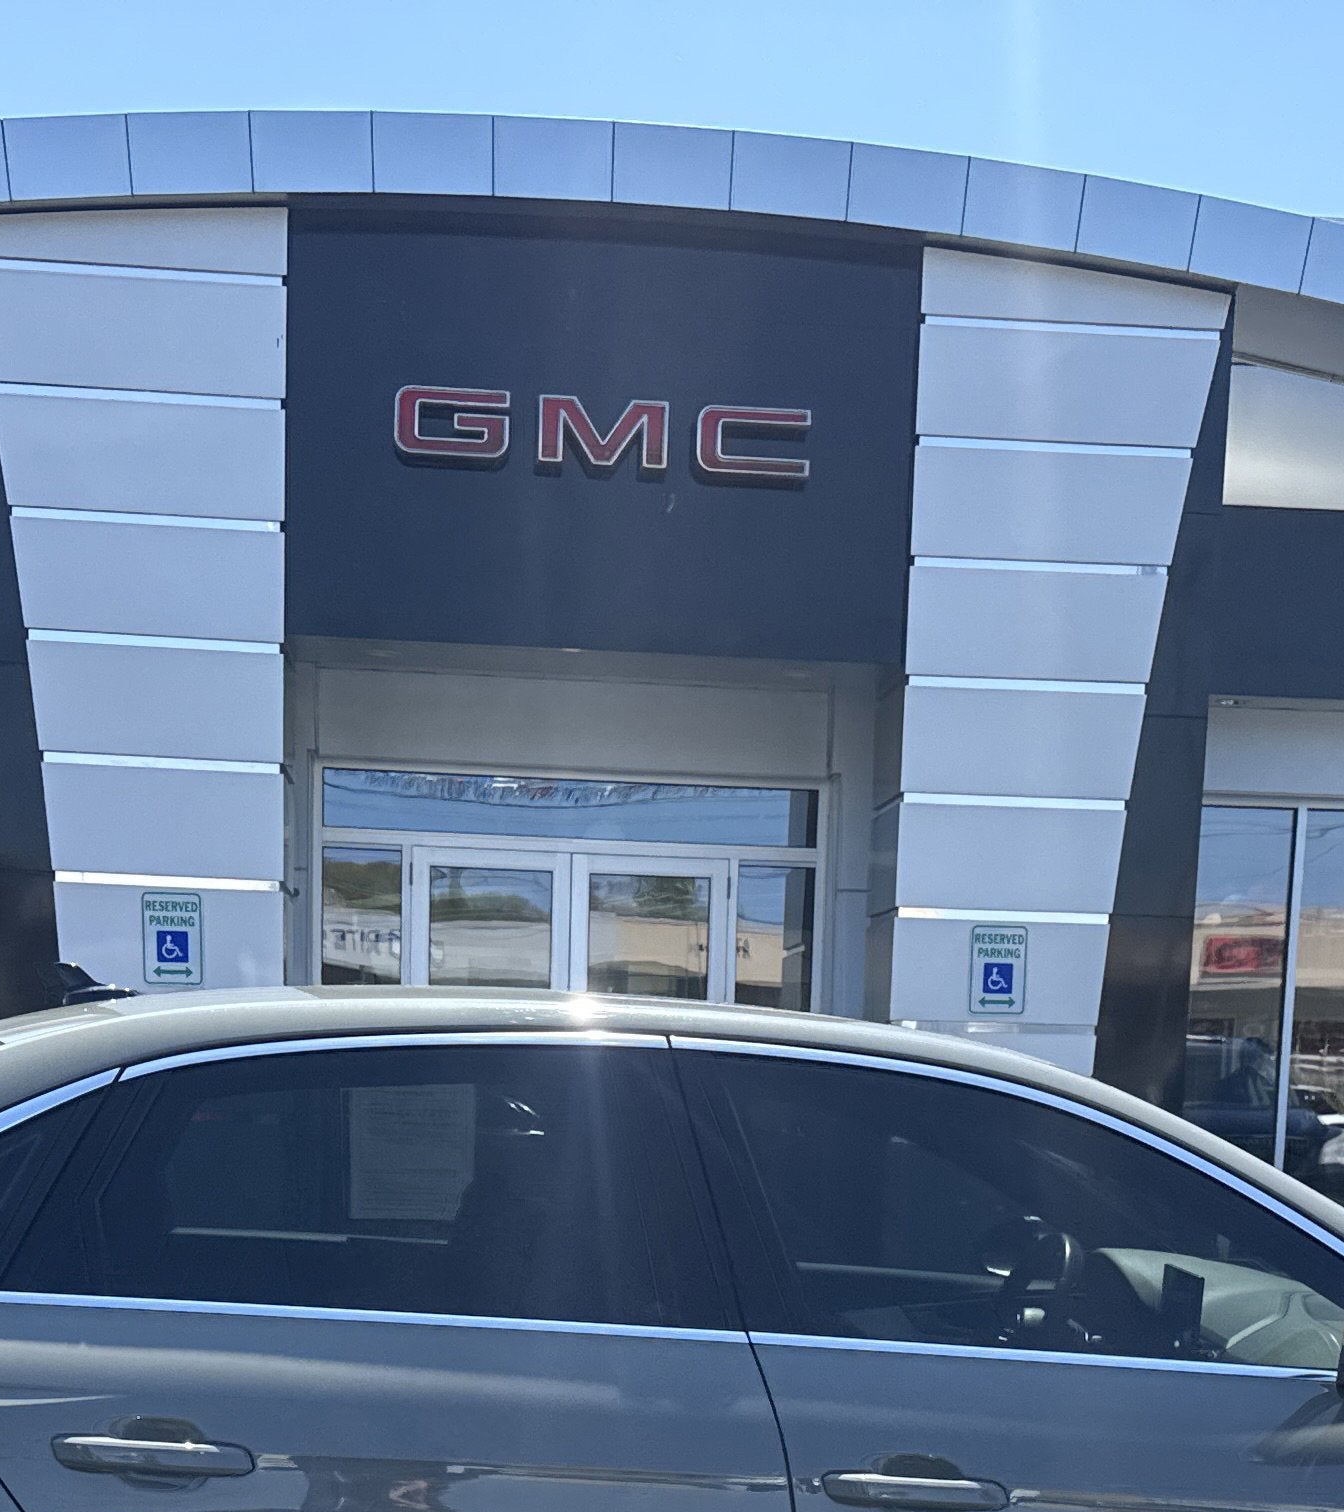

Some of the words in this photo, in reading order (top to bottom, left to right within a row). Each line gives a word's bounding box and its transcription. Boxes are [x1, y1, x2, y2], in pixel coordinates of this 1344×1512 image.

[394, 385, 812, 478] GMC
[144, 900, 198, 913] RESERVED
[148, 914, 196, 927] PARKING
[974, 933, 1025, 945] RESERVED
[977, 947, 1021, 959] PARKING
